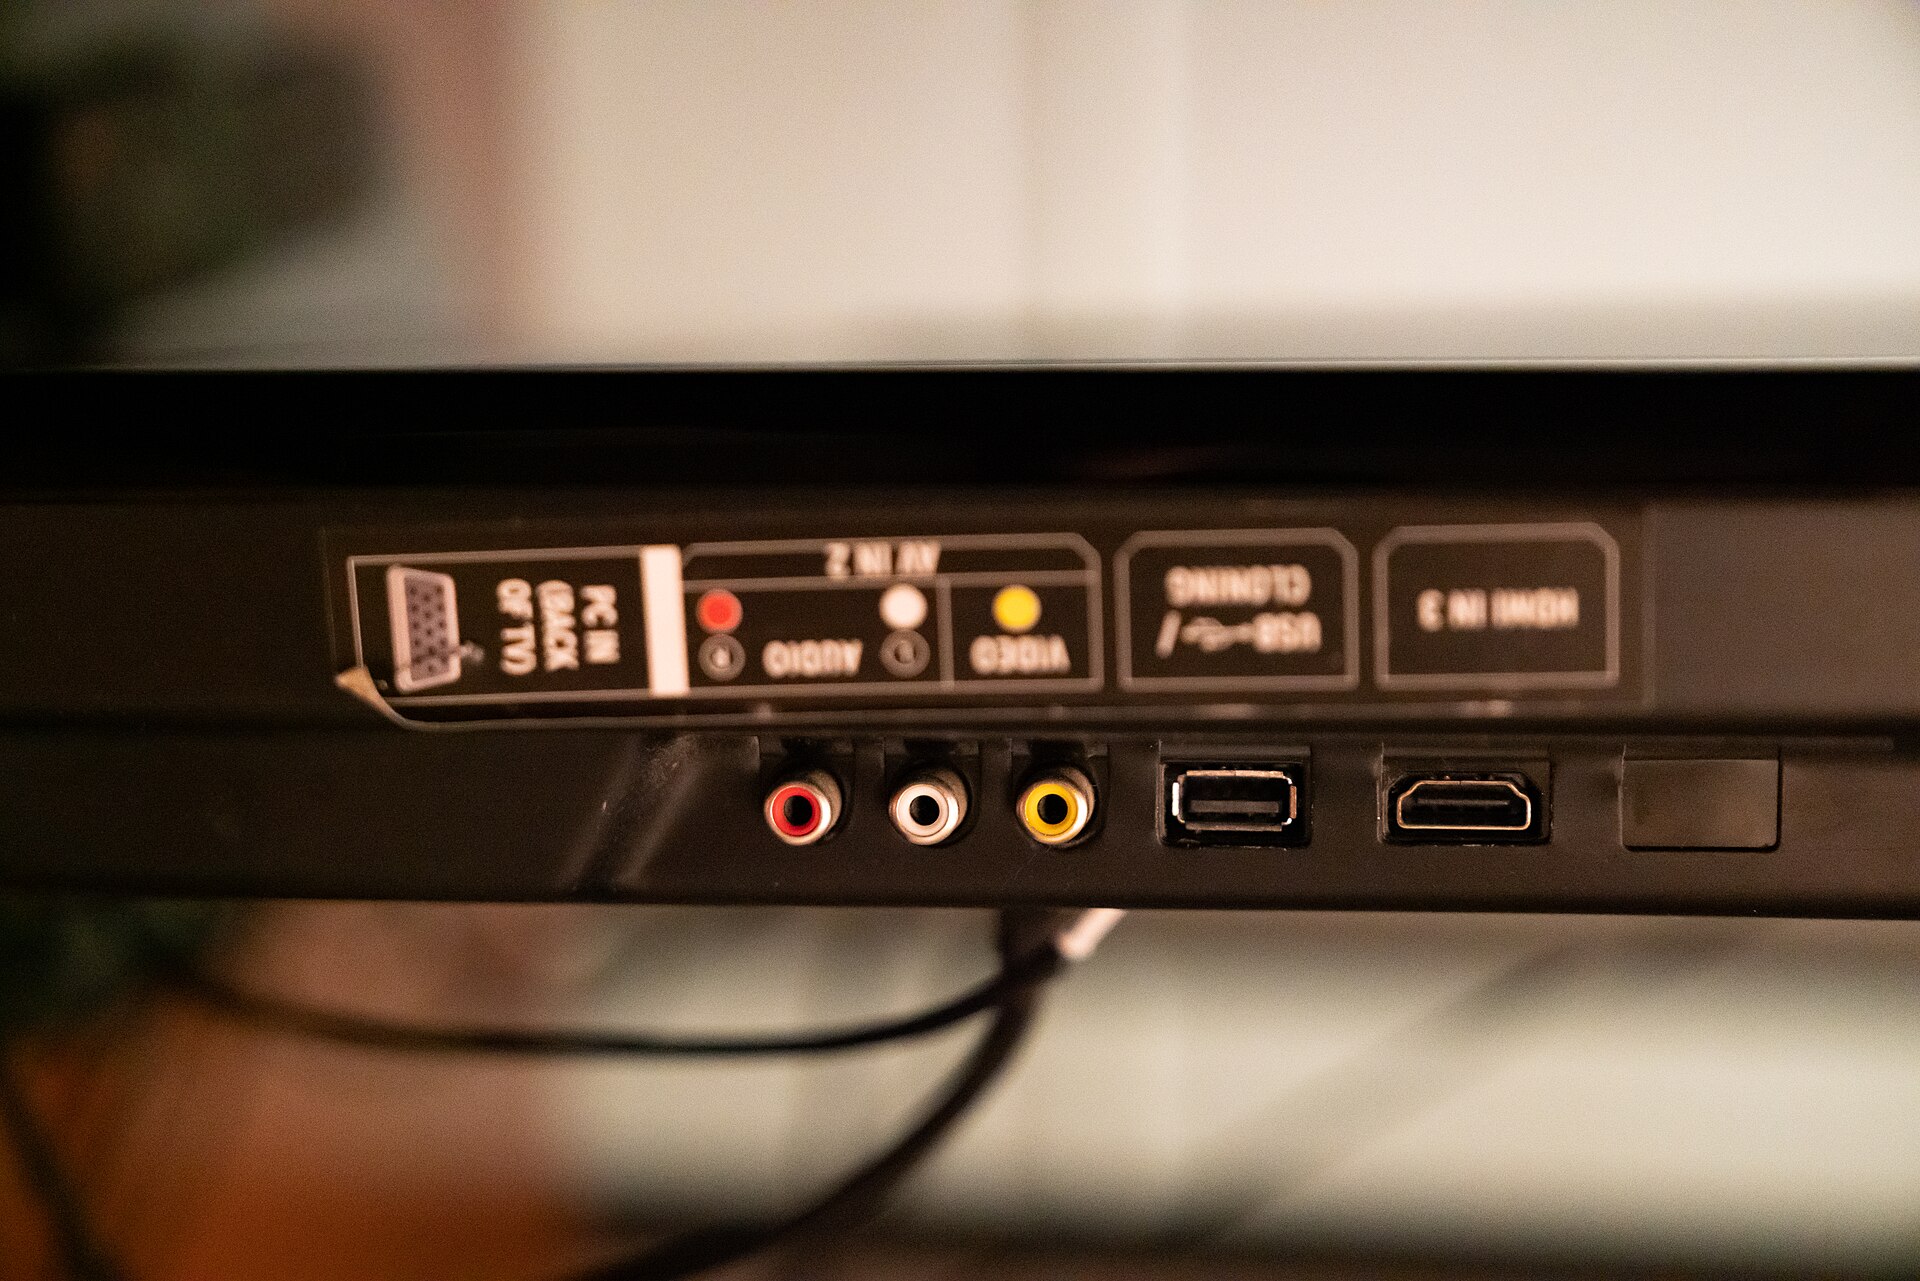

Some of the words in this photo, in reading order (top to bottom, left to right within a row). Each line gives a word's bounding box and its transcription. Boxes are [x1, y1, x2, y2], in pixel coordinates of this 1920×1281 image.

[825, 542, 851, 581] 2
[854, 542, 894, 577] IN
[898, 541, 942, 577] AV
[497, 578, 533, 618] OF
[580, 584, 618, 628] PC
[1165, 564, 1312, 607] CLONING
[1417, 589, 1443, 633] 3
[1446, 588, 1488, 630] IN
[1490, 587, 1579, 629] HDMI
[1254, 611, 1322, 654] USB
[762, 638, 863, 679] AUDIO
[969, 634, 1072, 675] VIDEO
